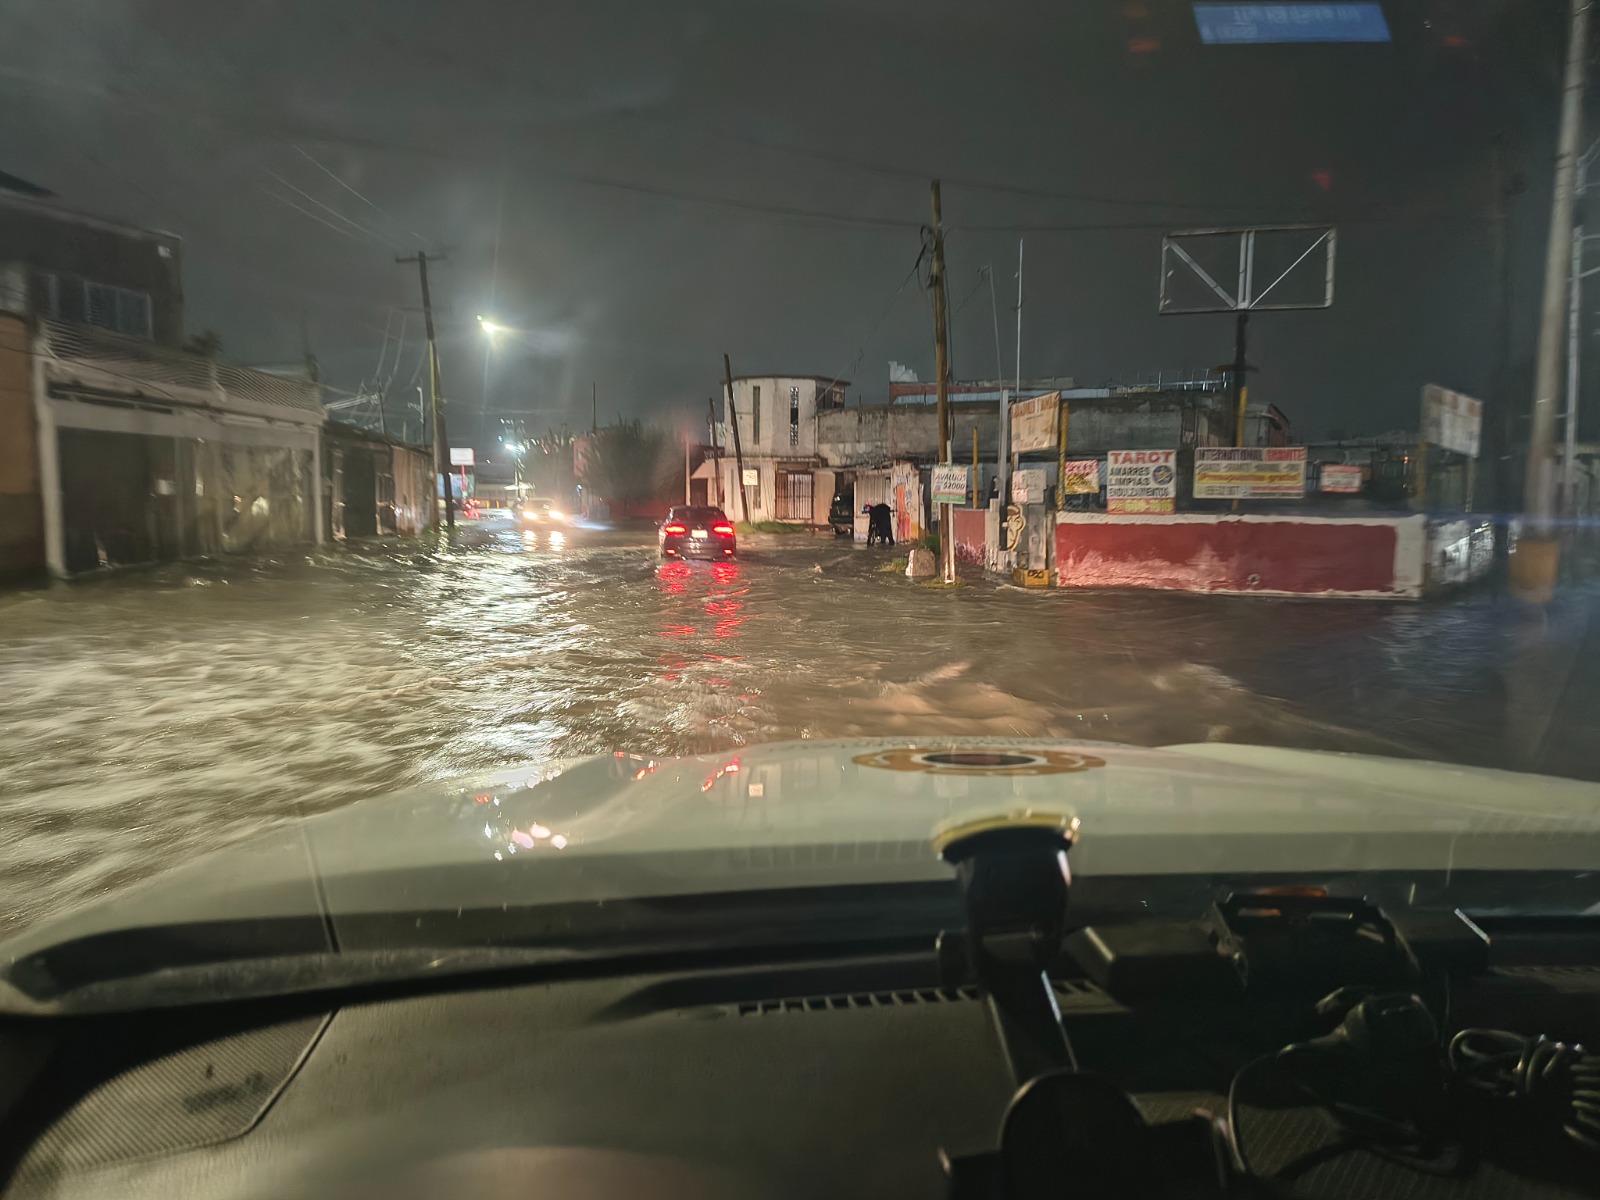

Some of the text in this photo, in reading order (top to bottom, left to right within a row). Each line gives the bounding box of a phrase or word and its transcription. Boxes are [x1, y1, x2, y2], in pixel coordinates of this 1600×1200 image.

[1110, 451, 1174, 465] TAROT
[1109, 466, 1151, 476] AMARRES
[1108, 477, 1151, 486] LIMPIAS
